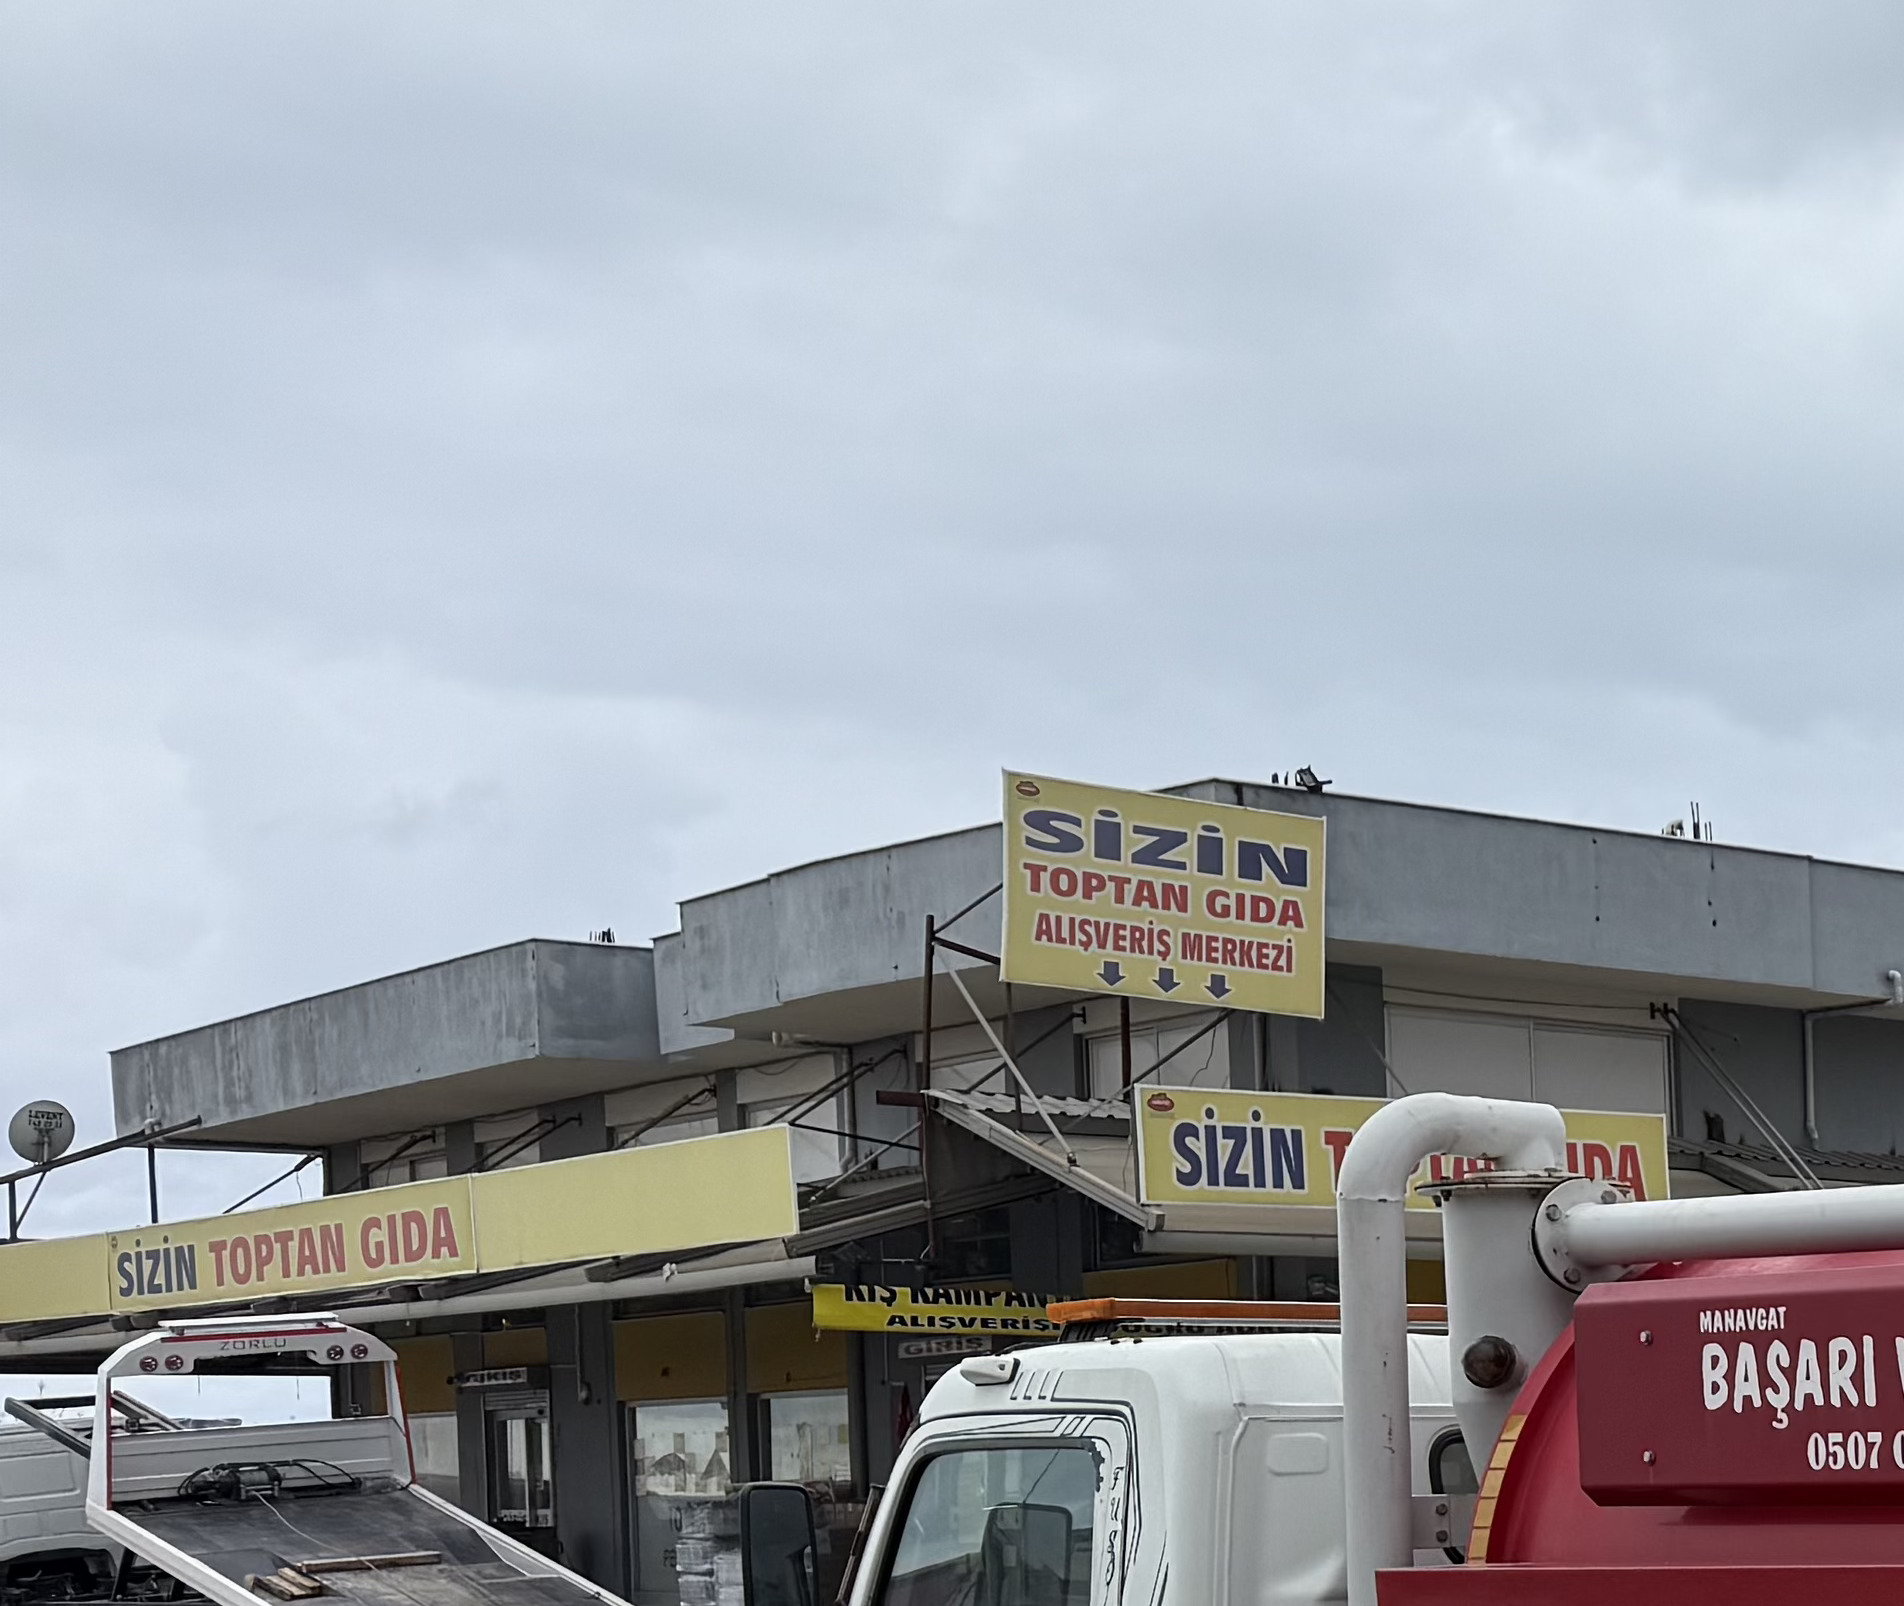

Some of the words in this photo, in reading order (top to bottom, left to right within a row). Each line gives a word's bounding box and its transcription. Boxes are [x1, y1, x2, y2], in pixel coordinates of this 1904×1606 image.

[1022, 808, 1308, 888] SİZİN
[1023, 862, 1188, 914] TOPTAN
[1206, 888, 1304, 929] GIDA
[1035, 912, 1171, 961] ALIŞVERİŞ
[1181, 932, 1293, 974] MERKEZİ
[1172, 1106, 1306, 1191] SİZİN
[117, 1235, 198, 1297] SİZİN
[208, 1222, 347, 1288] TOPTAN
[360, 1205, 460, 1270] GIDA
[220, 1337, 287, 1351] ZORLU
[1699, 1306, 1787, 1333] MANAVGAT
[1701, 1334, 1877, 1430] BAŞARI
[1807, 1431, 1883, 1471] 0507
